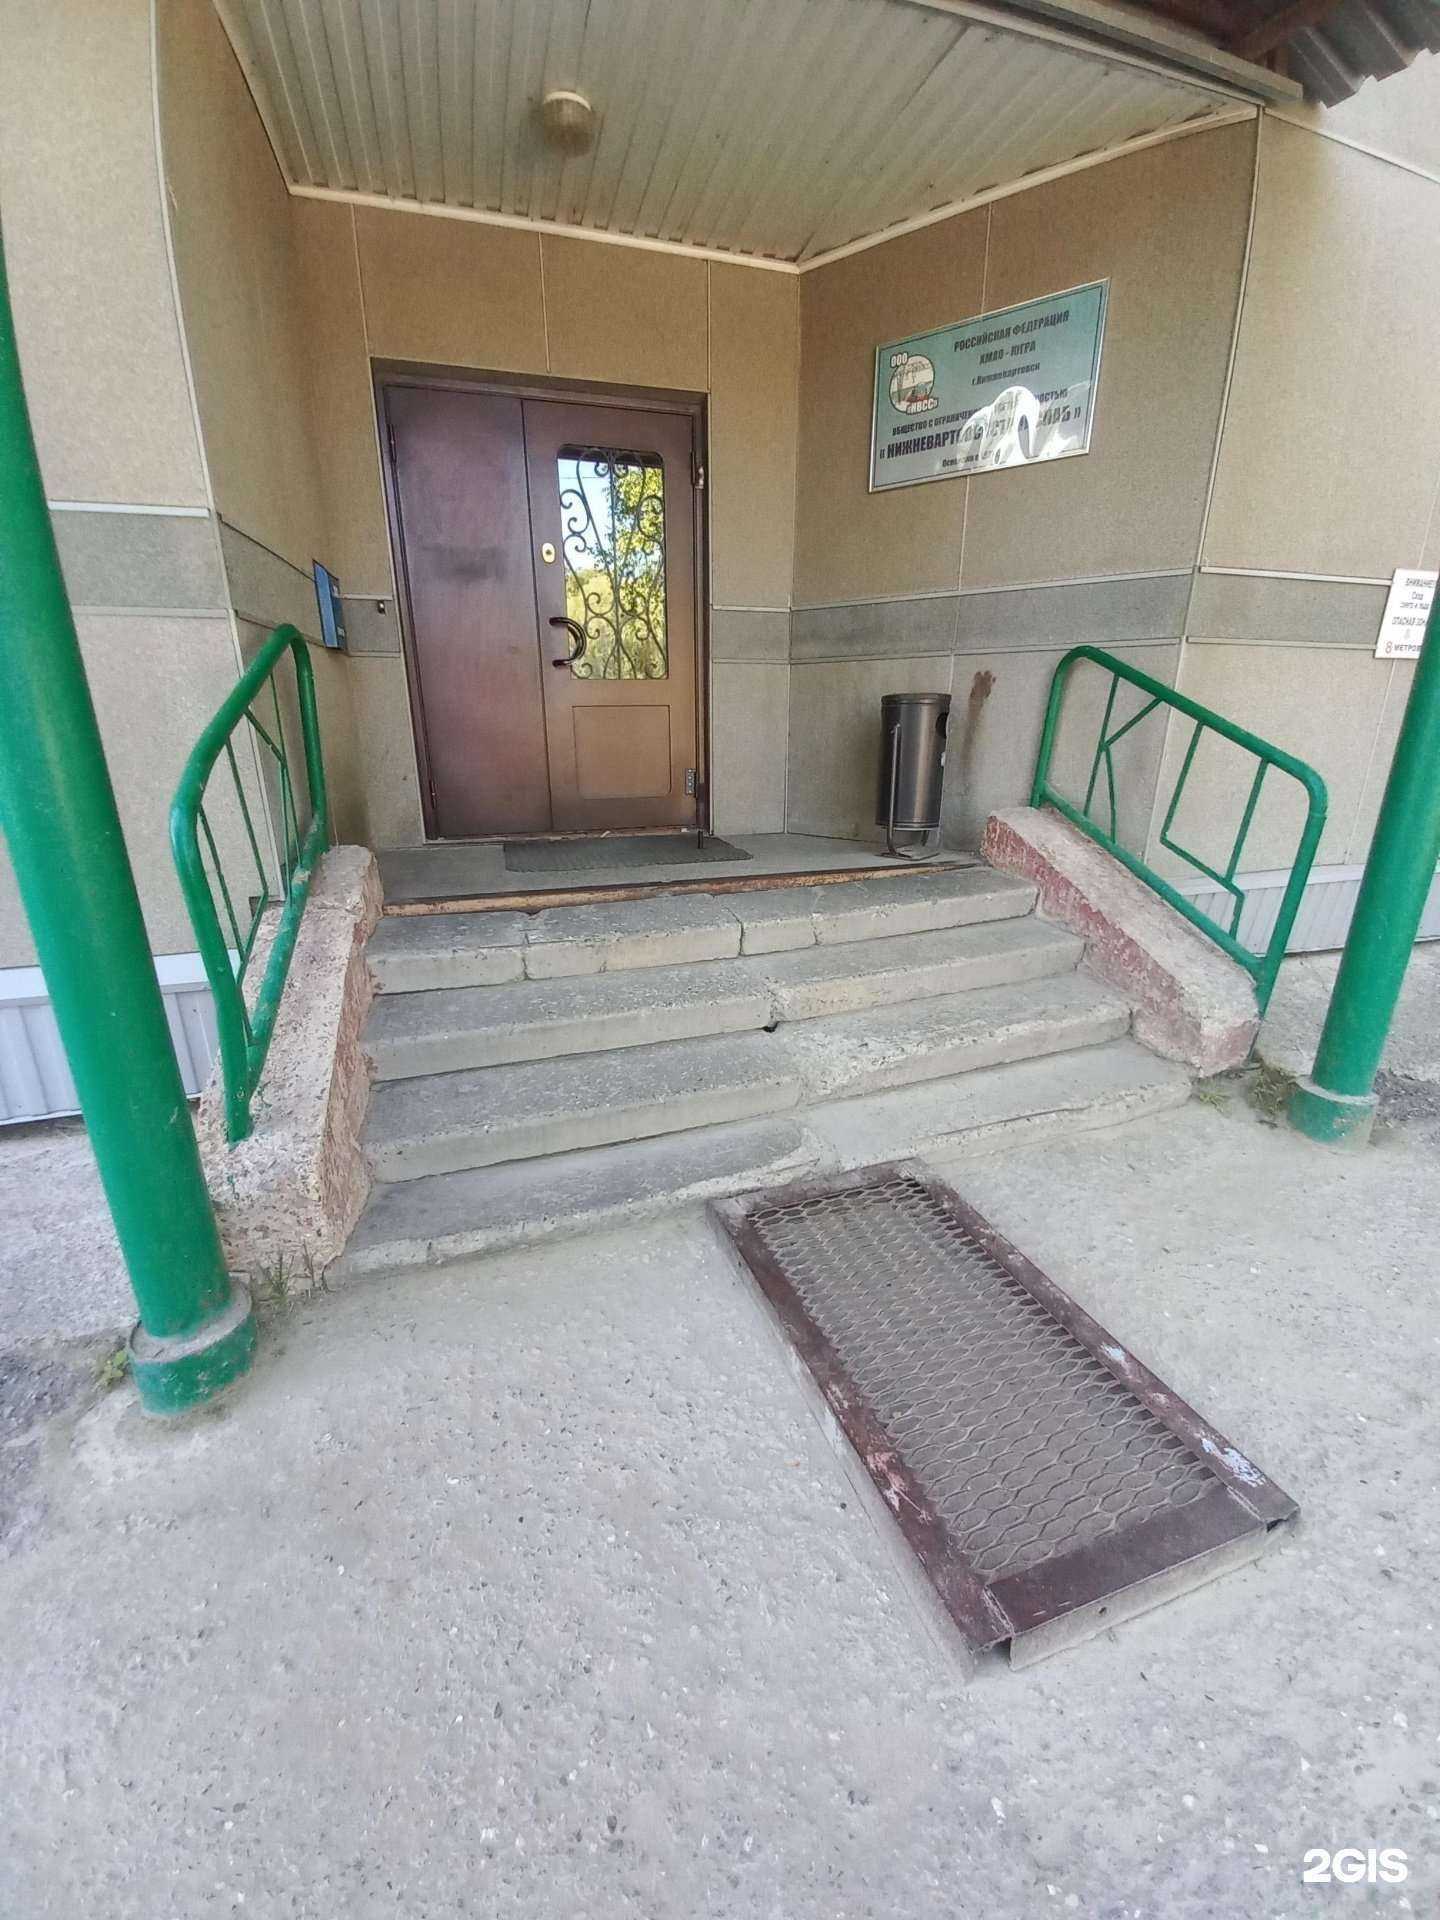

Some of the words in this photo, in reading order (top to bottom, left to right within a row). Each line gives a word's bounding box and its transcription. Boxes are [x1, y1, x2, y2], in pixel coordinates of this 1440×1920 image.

[954, 326, 1011, 352] РОССИЙСКАЯ
[1012, 310, 1070, 336] ФЕДЕРАЦИЯ
[1011, 341, 1036, 356] ЮГРА
[890, 352, 908, 369] ООО
[892, 418, 927, 436] ОБЩЕСТВО
[1385, 641, 1393, 654] 8
